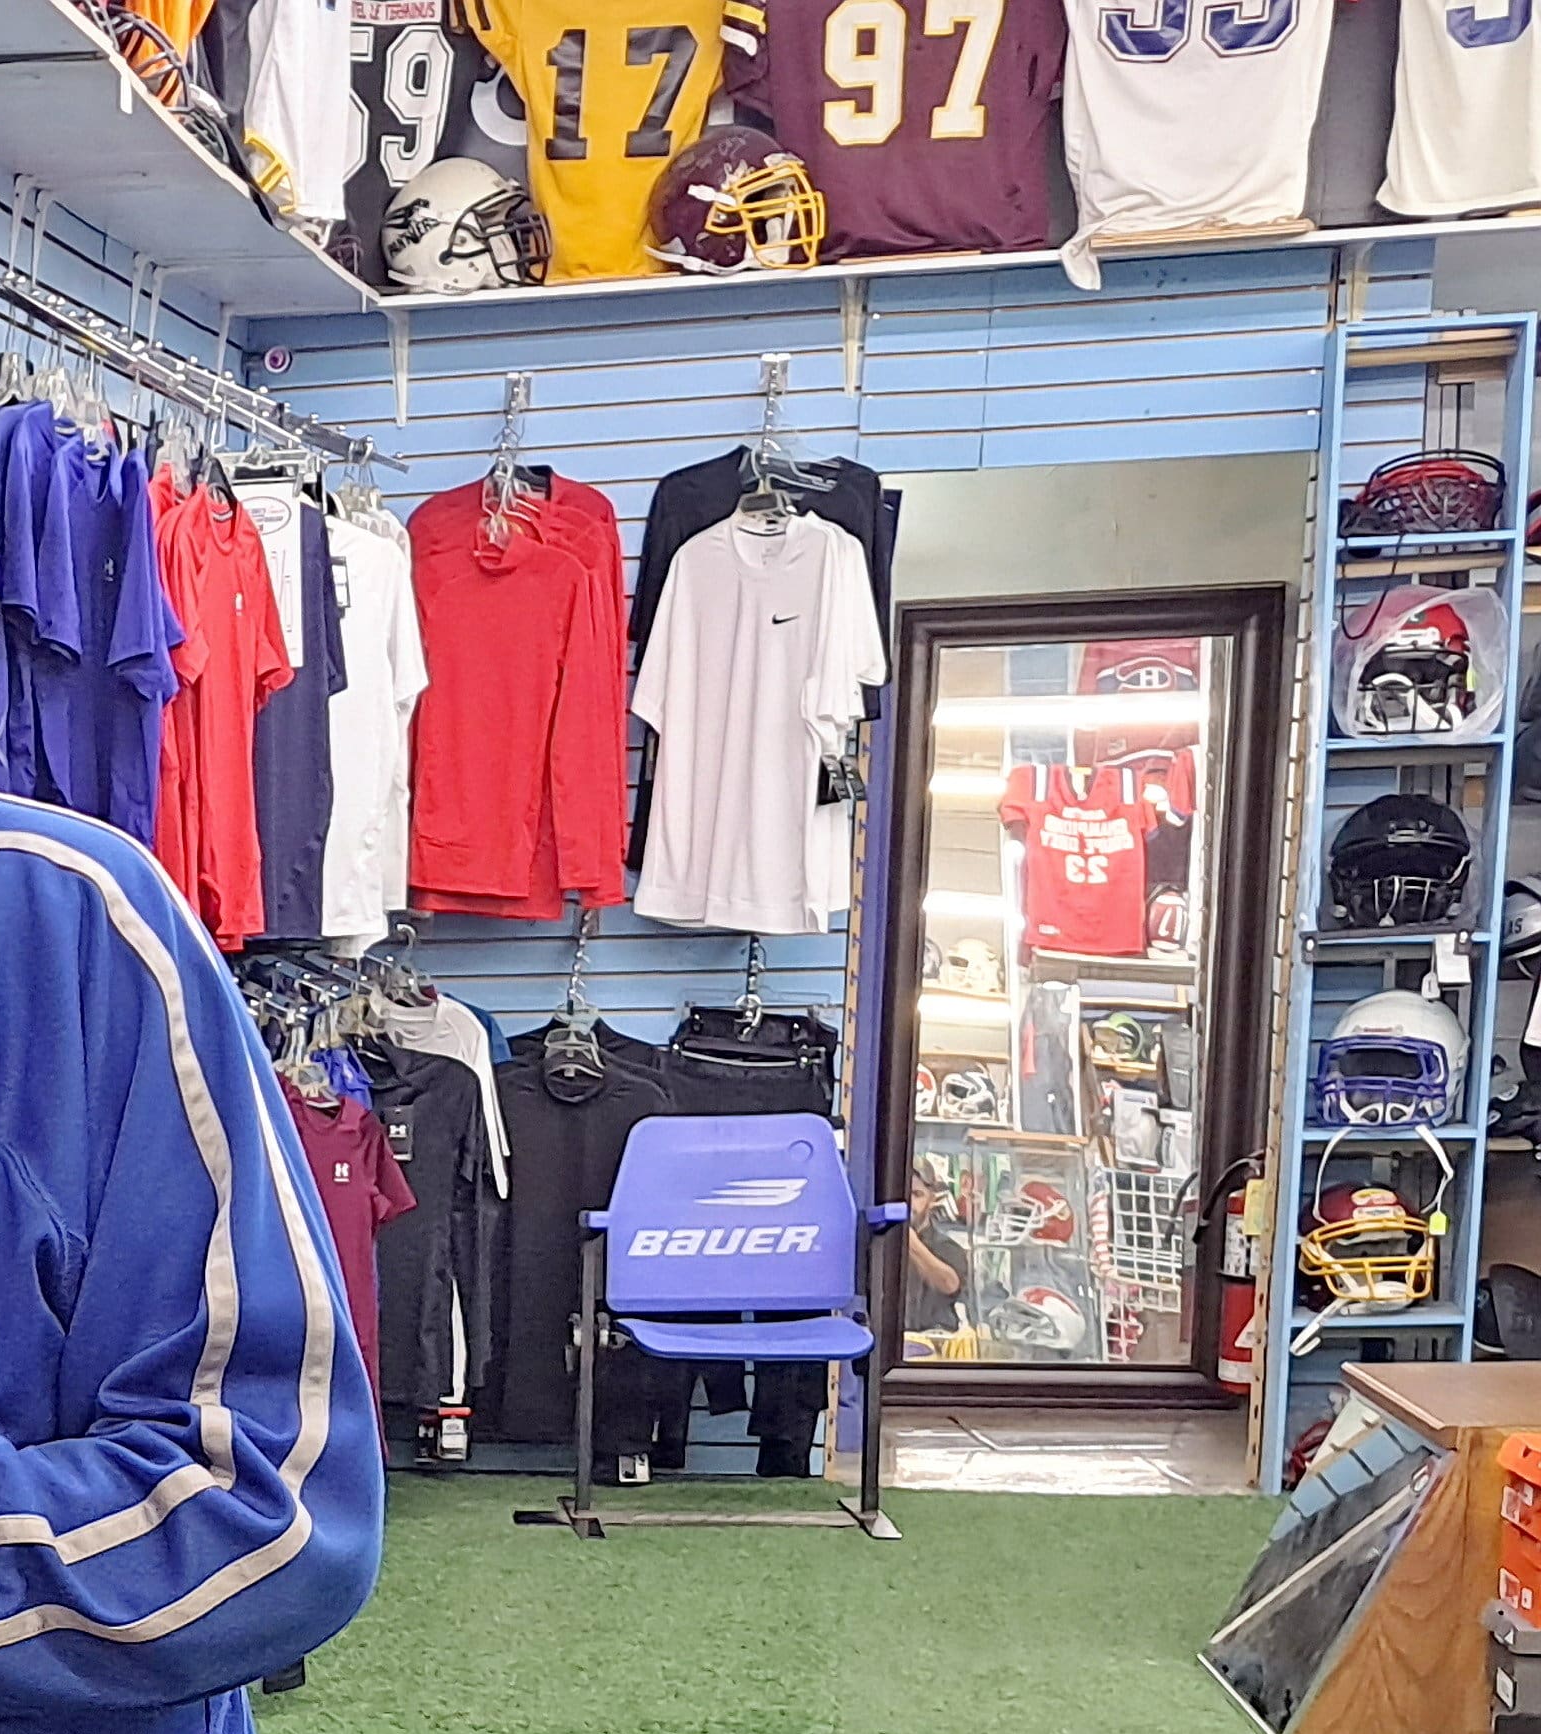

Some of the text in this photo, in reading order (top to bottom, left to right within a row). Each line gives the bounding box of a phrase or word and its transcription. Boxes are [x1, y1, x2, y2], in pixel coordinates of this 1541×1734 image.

[544, 26, 699, 161] 17
[823, 0, 1004, 146] 97
[627, 1225, 821, 1257] BAUER
